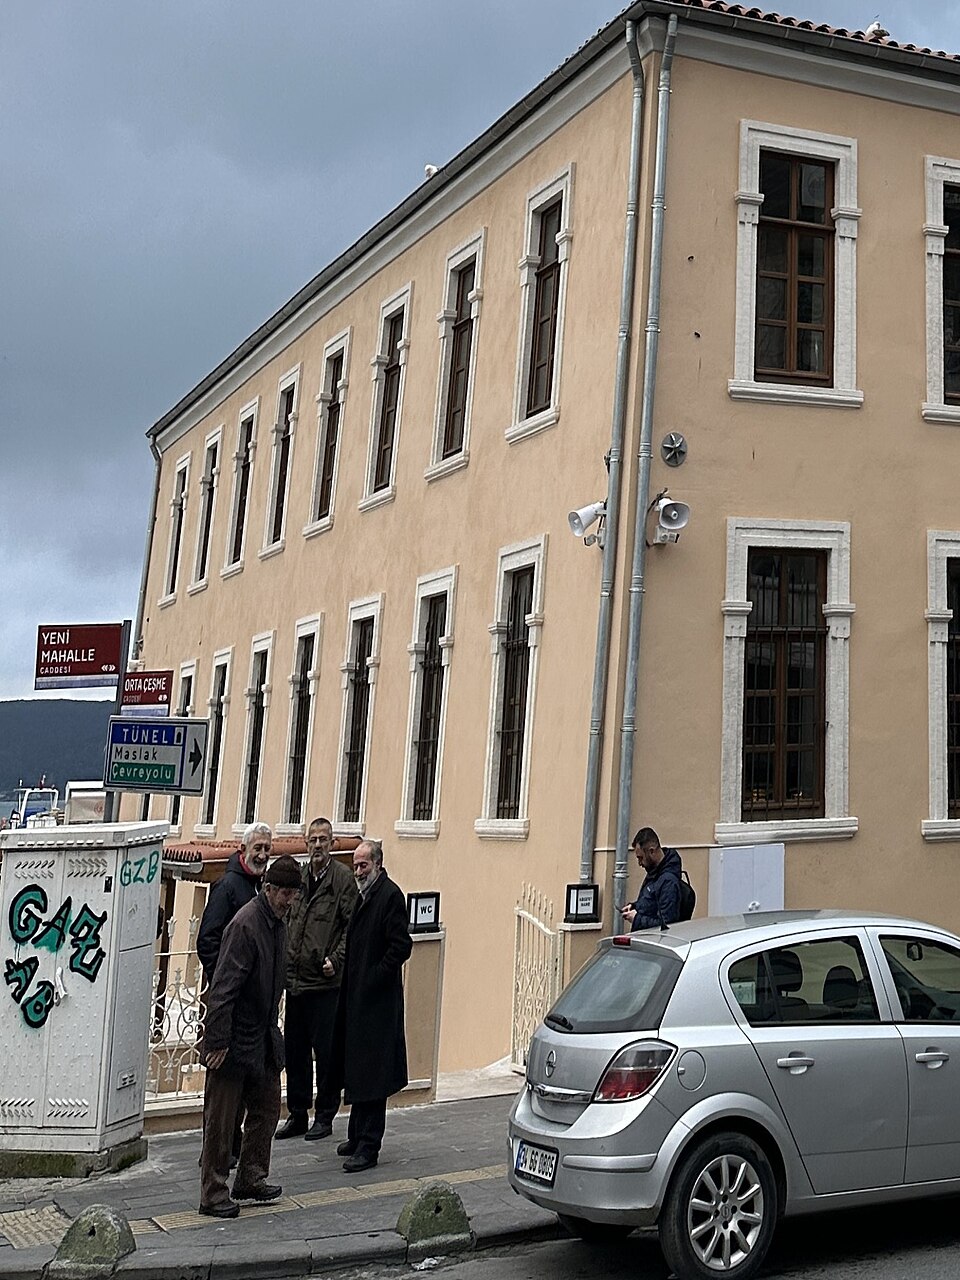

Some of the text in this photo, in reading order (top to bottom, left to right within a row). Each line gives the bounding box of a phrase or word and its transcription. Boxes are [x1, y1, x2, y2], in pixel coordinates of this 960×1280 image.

[41, 629, 70, 645] YENİ
[41, 648, 96, 664] MAHALLE
[39, 665, 72, 675] CADDESİ
[124, 678, 143, 692] ORTA
[143, 677, 167, 694] ÇEŞME
[122, 725, 169, 744] TÜNEL
[114, 746, 158, 761] Maslak
[112, 763, 172, 782] Çevreyolu
[420, 905, 433, 915] WC
